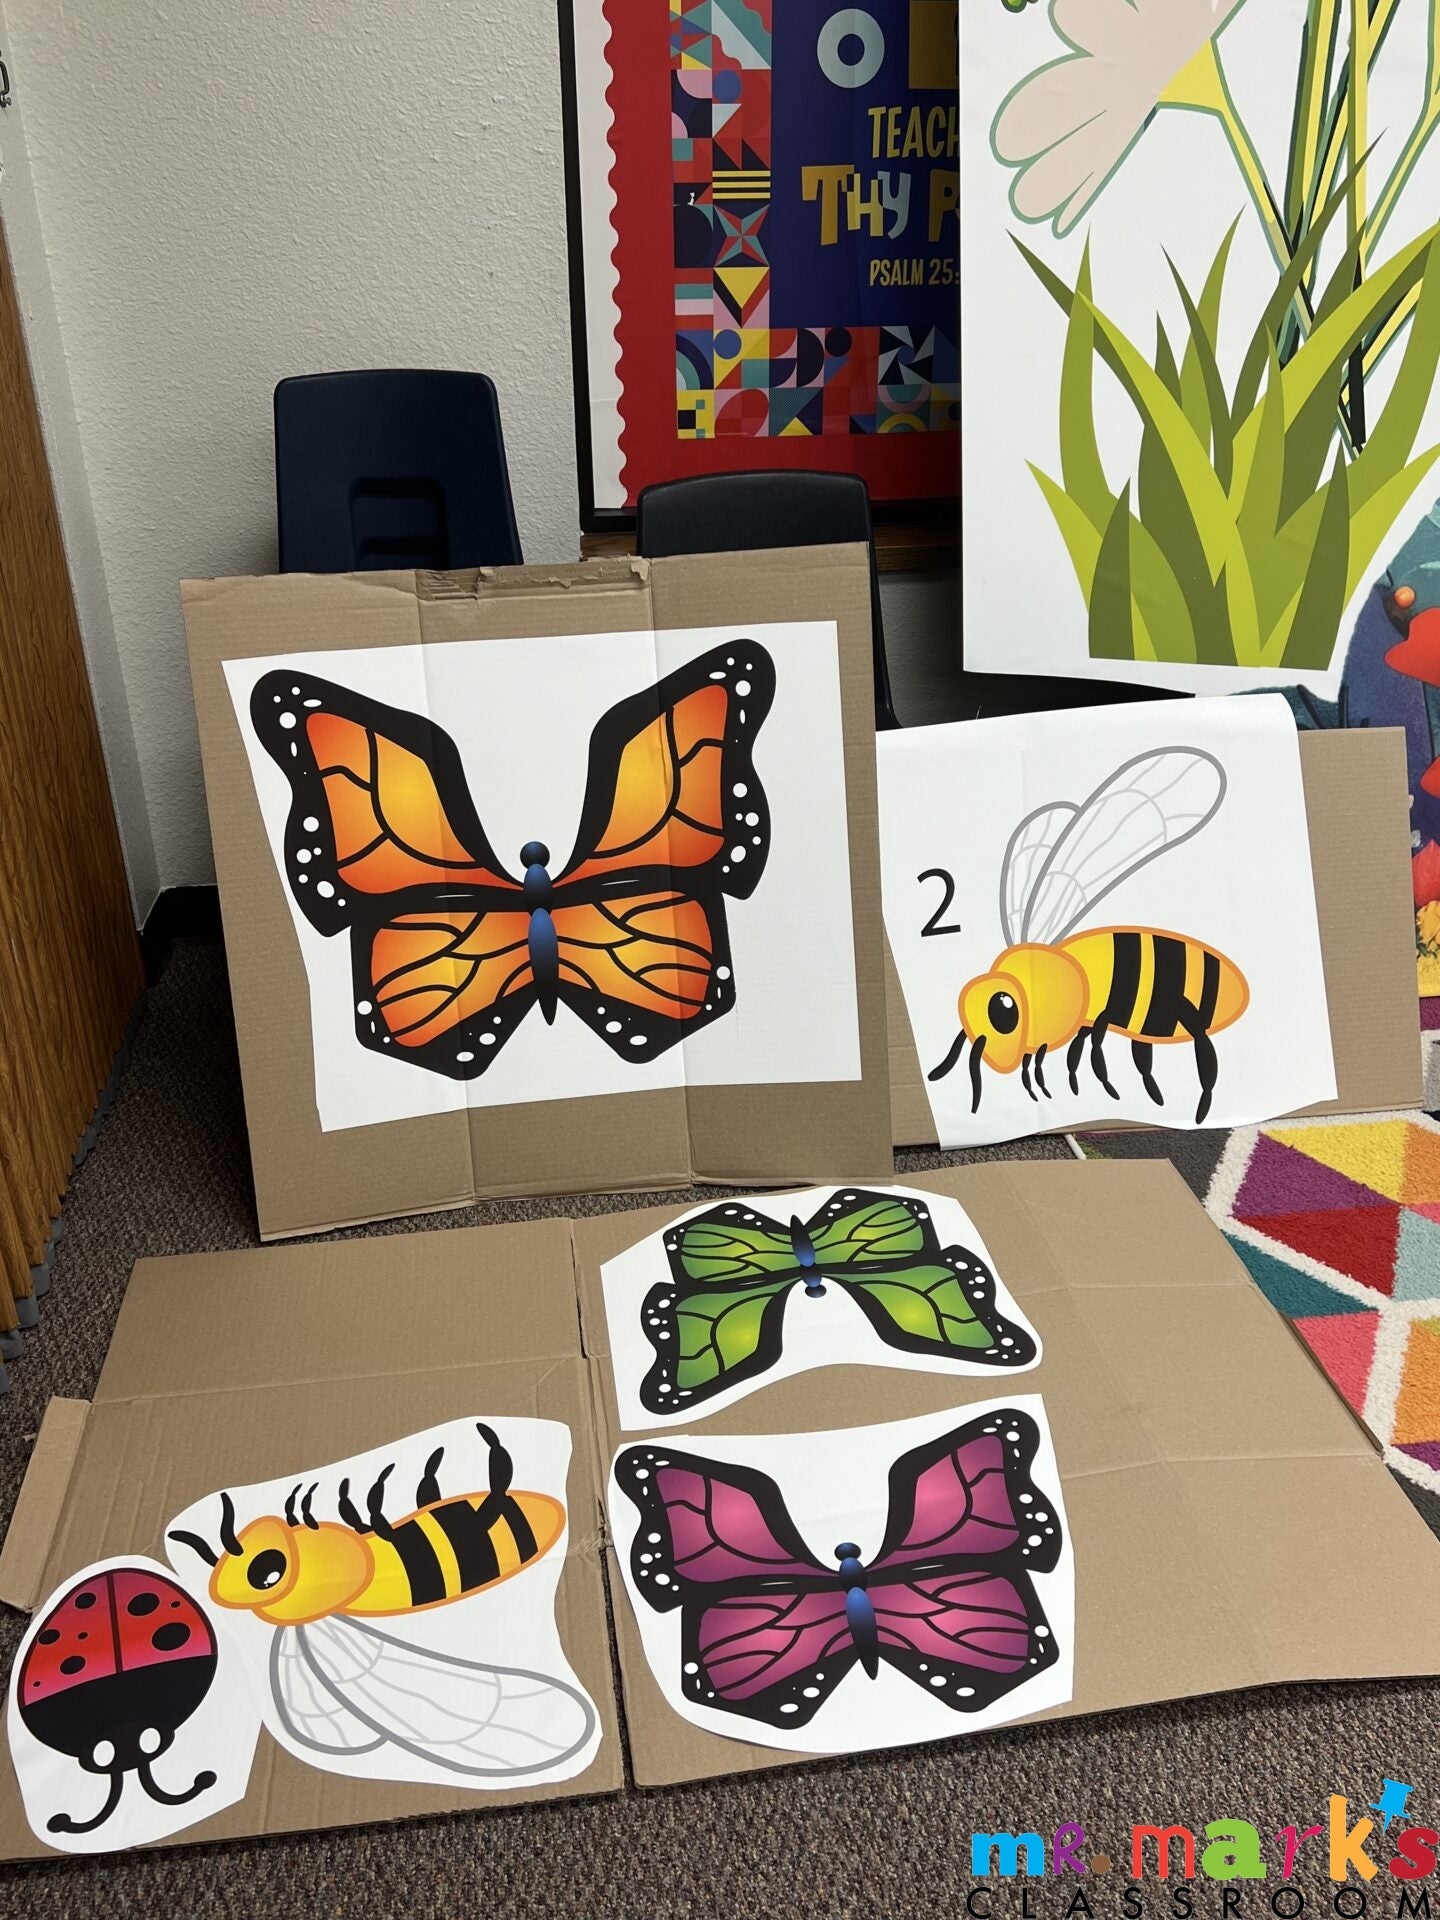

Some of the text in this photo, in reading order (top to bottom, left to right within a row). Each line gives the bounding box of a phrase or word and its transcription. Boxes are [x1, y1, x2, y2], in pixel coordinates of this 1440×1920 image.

[868, 105, 960, 159] TEACH
[869, 258, 924, 286] PSALM
[917, 868, 961, 937] 2
